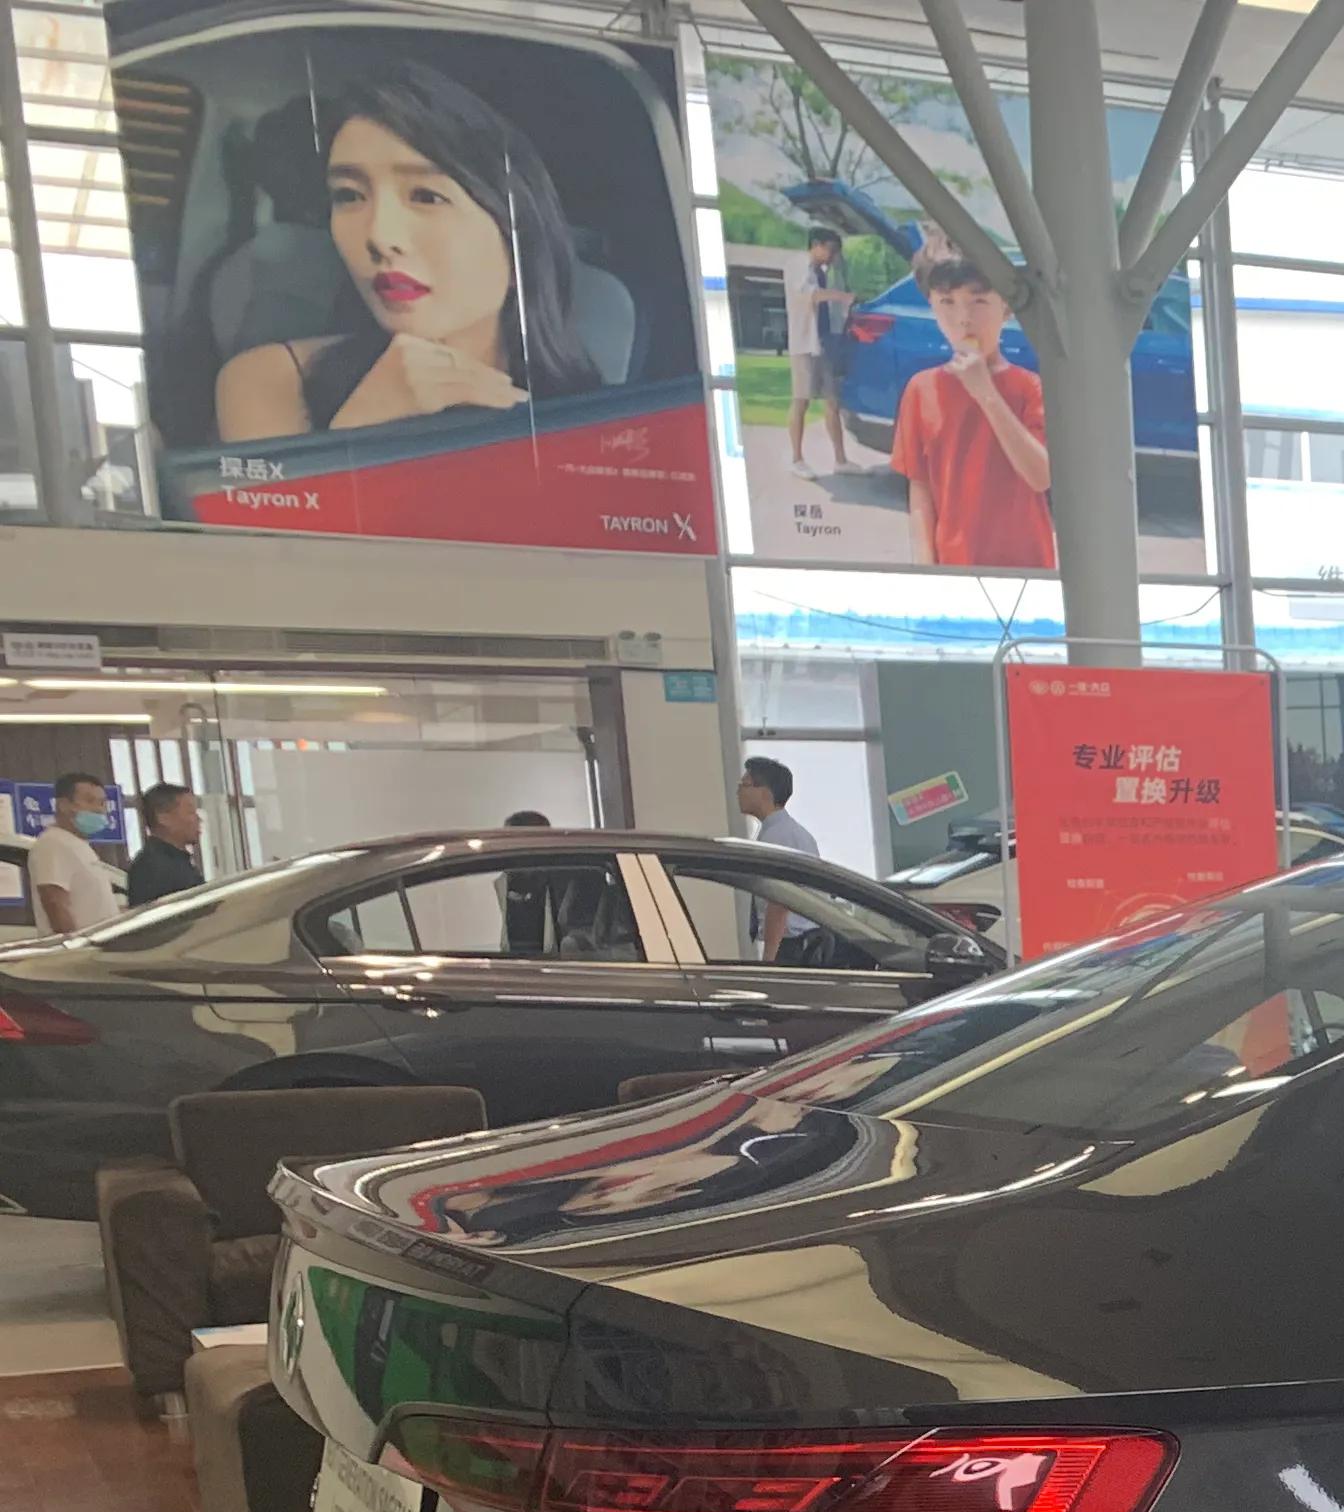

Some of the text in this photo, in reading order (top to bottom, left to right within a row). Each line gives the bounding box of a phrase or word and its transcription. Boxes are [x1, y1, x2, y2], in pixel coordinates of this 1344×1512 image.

[222, 485, 319, 510] Tayron X
[601, 512, 696, 541] TAYRON X
[795, 521, 841, 537] Tayron
[1073, 744, 1182, 772] 专业评估
[1113, 777, 1221, 804] 置换升级
